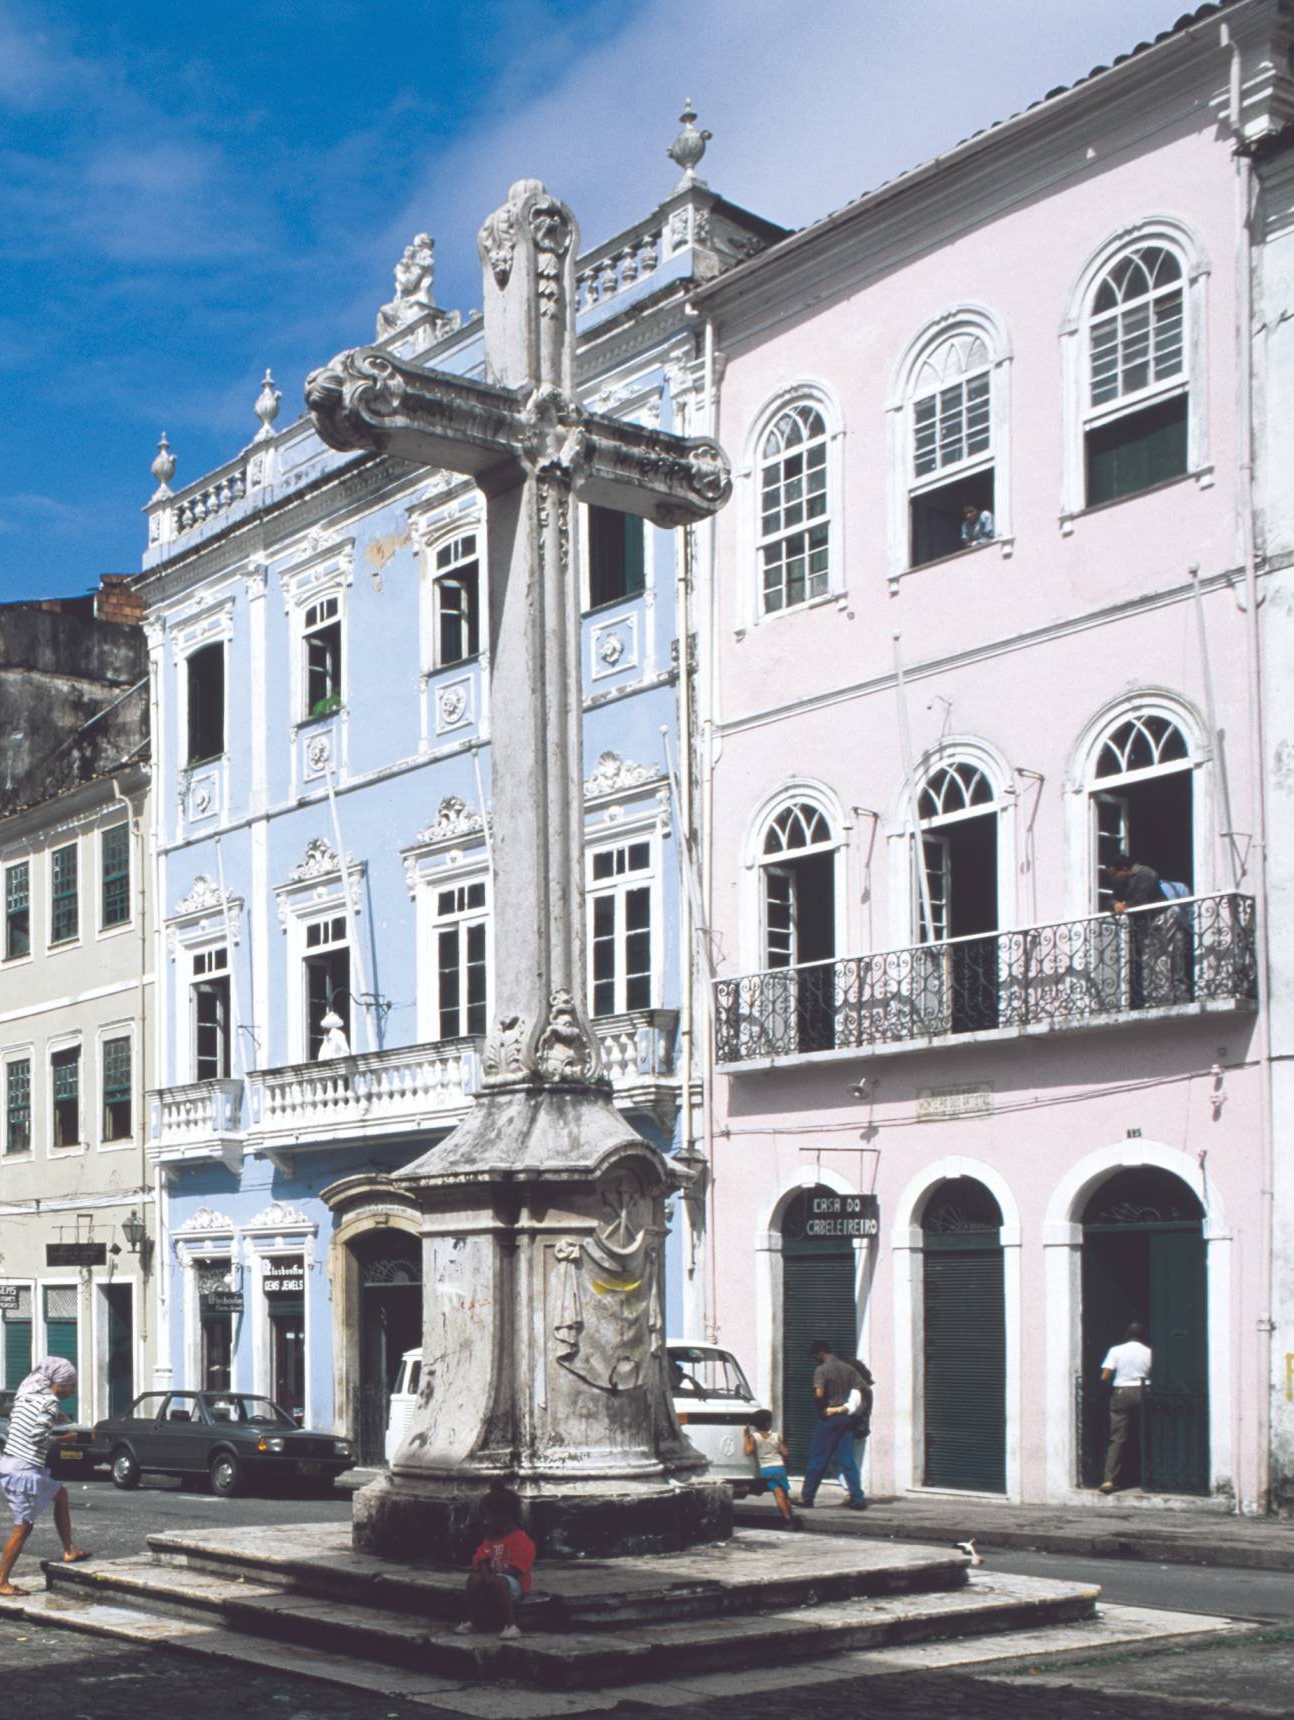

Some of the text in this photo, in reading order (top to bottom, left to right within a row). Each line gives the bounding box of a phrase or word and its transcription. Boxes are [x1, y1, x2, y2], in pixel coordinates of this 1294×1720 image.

[813, 1198, 860, 1212] CASA DO
[807, 1219, 877, 1235] CABELEIREIRO
[264, 1280, 303, 1291] GEMS JEWELS
